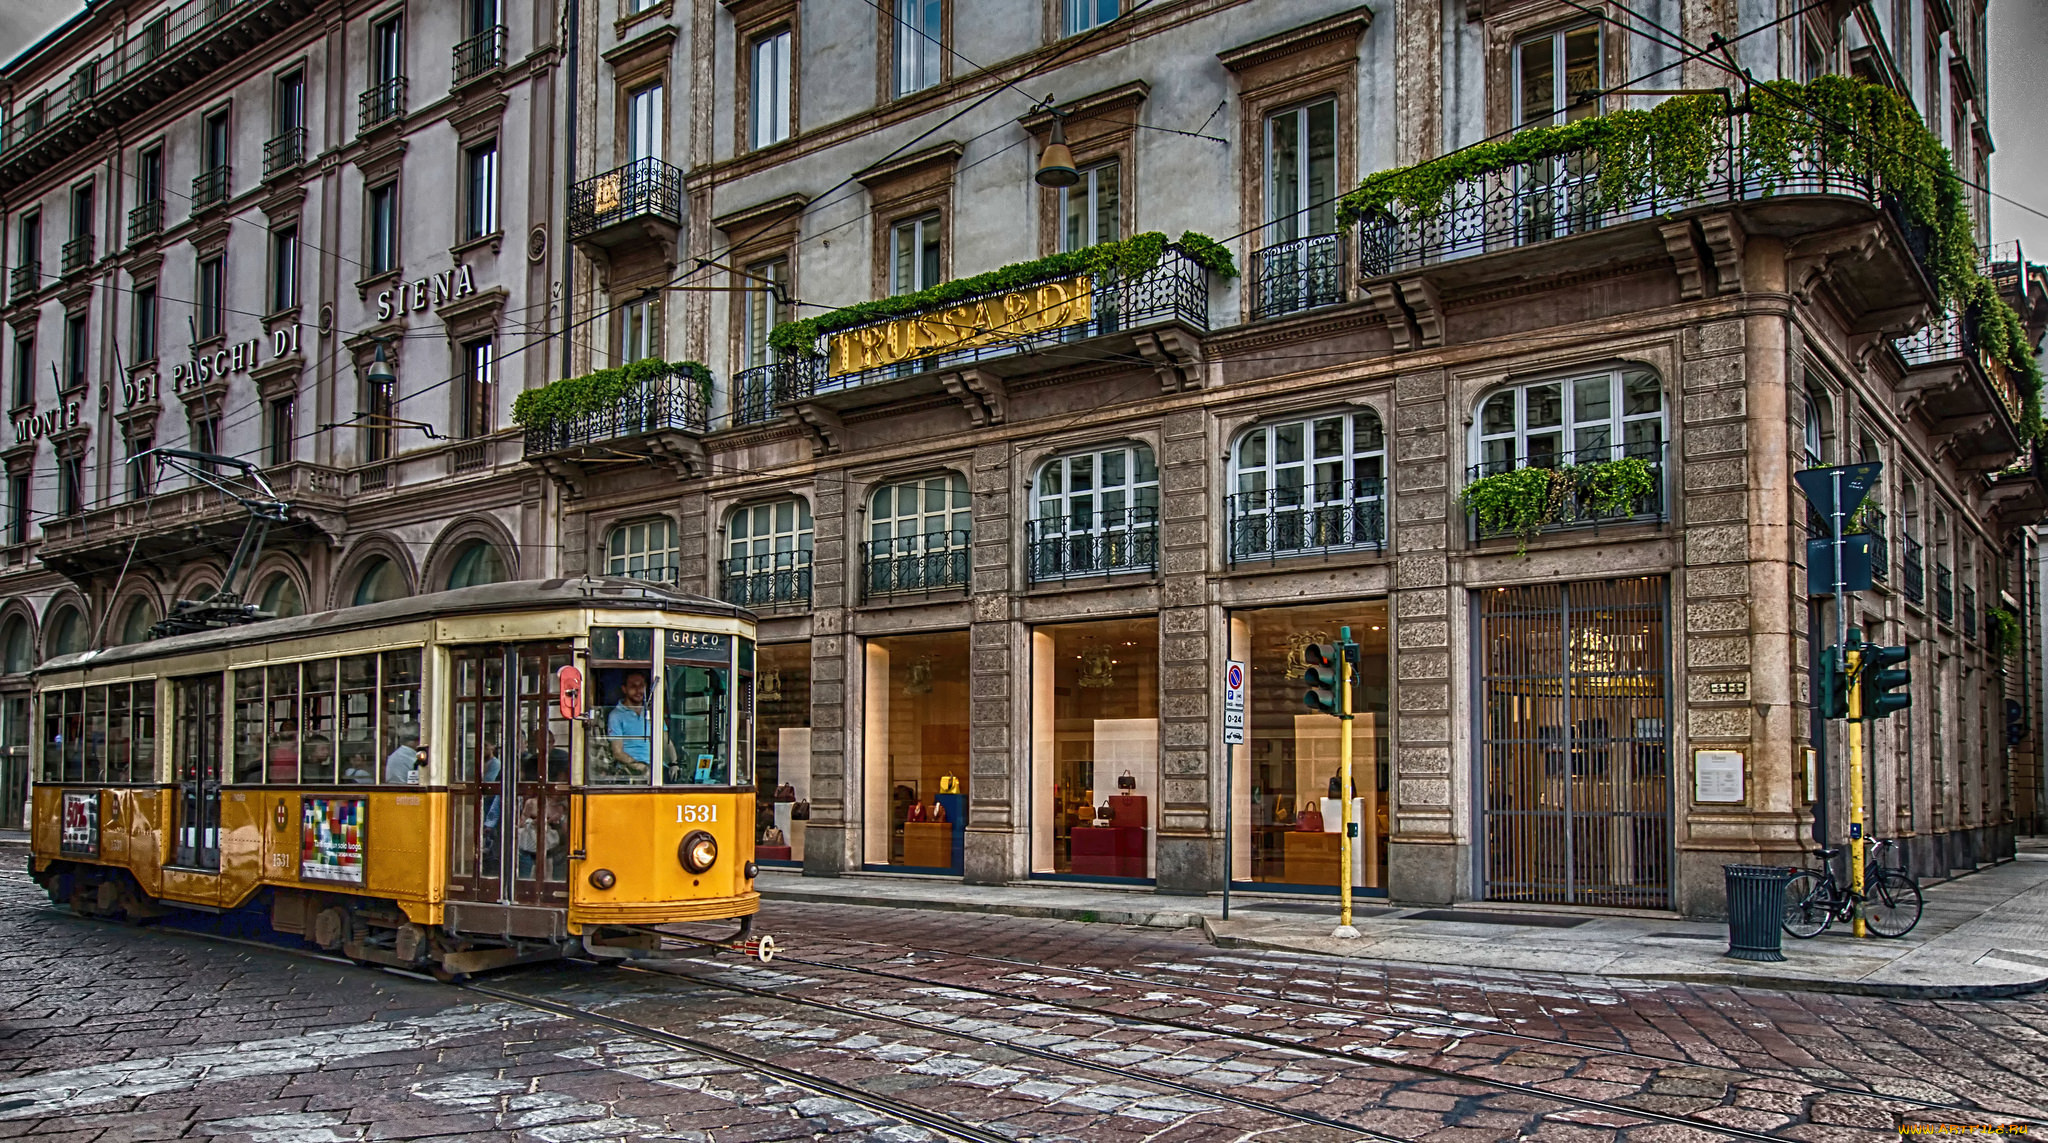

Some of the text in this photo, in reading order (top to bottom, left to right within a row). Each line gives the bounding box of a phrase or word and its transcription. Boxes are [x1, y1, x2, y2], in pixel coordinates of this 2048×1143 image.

[831, 276, 1091, 374] TRUSSARDI
[15, 265, 474, 443] MONTE DEI PASCHI DI SIENA
[672, 631, 719, 646] GRECO
[1227, 714, 1242, 723] 0-24
[676, 804, 718, 823] 1531
[272, 853, 290, 868] 1531
